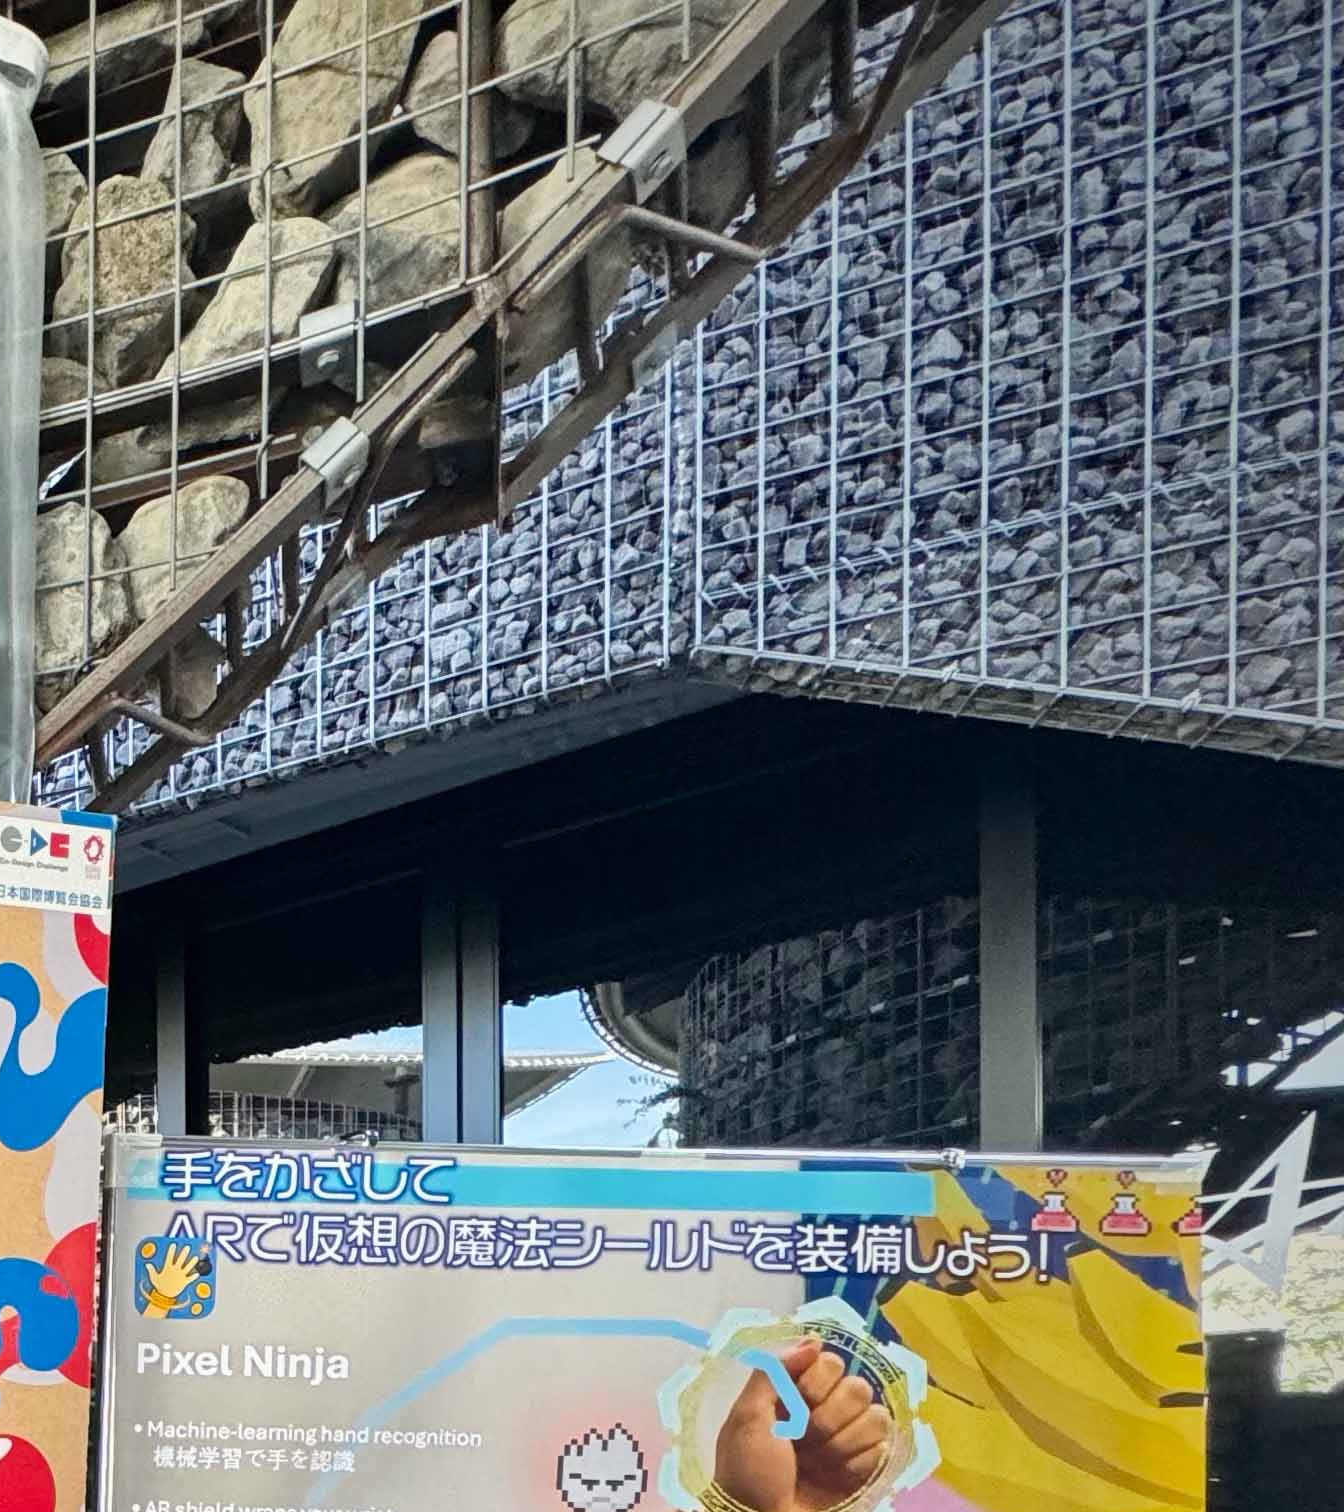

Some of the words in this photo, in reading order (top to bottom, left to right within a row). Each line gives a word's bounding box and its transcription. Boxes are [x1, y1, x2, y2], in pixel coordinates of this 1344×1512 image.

[164, 1150, 457, 1205] 手をかざして
[137, 1343, 232, 1377] Pixel
[244, 1346, 350, 1386] Ninja
[147, 1421, 318, 1444] Machine-learning
[321, 1426, 369, 1443] hand
[374, 1428, 482, 1449] recognition
[153, 1447, 356, 1472] 機械学習で手を認識
